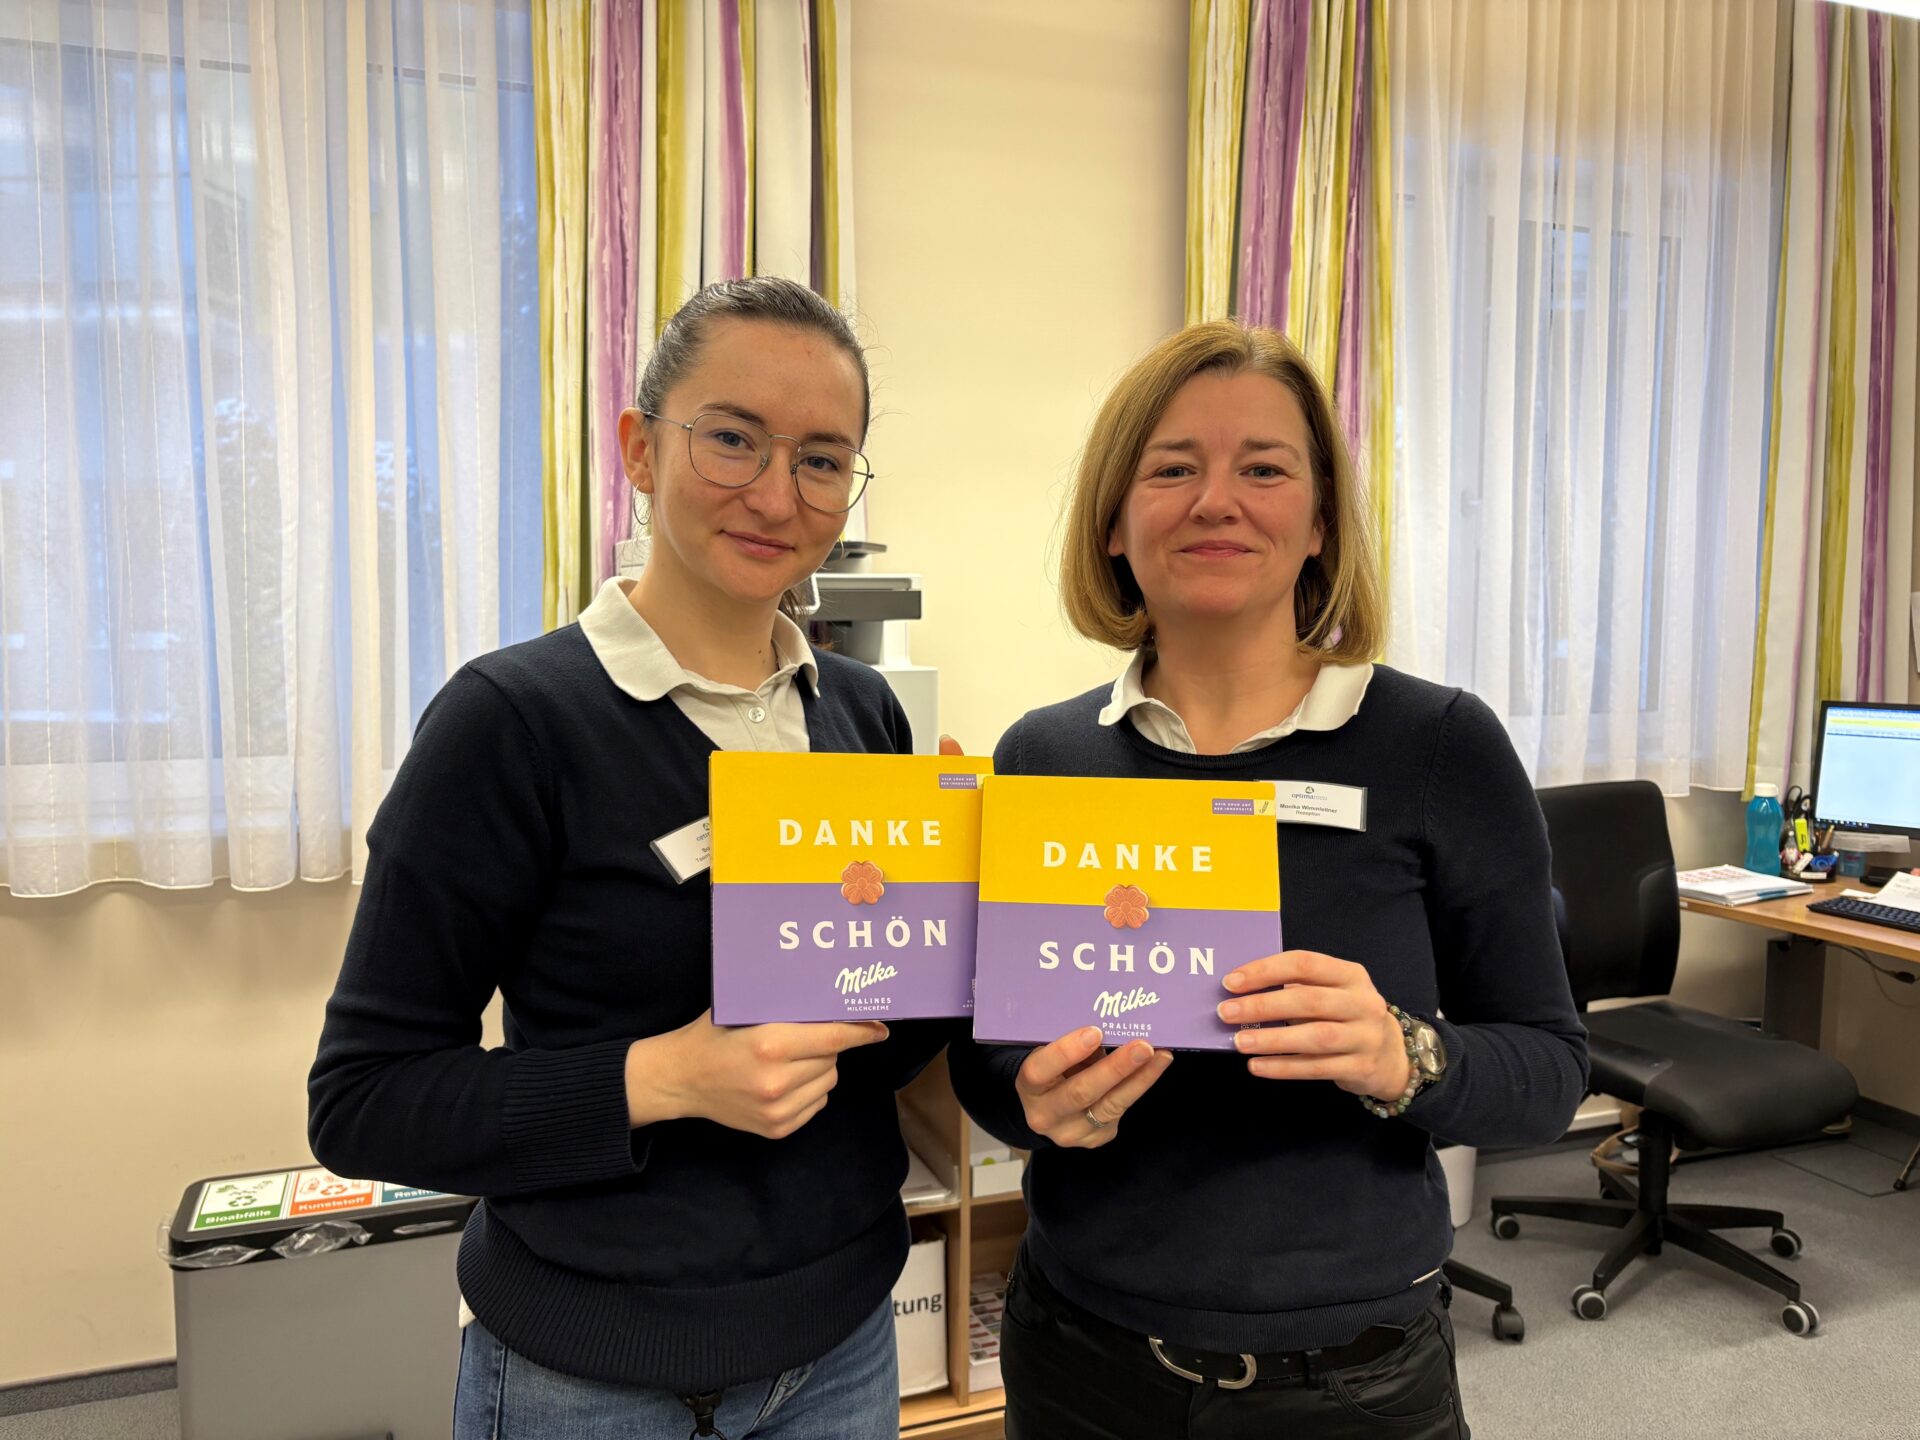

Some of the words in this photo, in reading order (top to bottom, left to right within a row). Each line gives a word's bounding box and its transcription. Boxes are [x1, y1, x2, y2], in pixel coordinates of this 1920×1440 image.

[778, 819, 942, 846] DANKE
[1043, 841, 1213, 873] DANKE
[779, 916, 947, 950] SCHÖN
[1039, 941, 1215, 976] SCHÖN
[835, 961, 898, 995] Milka
[844, 997, 892, 1005] PRALINES
[1093, 987, 1160, 1018] Milka
[1102, 1022, 1152, 1031] PRALINES
[299, 1197, 365, 1211] Kunststoff
[893, 1293, 942, 1316] tung
